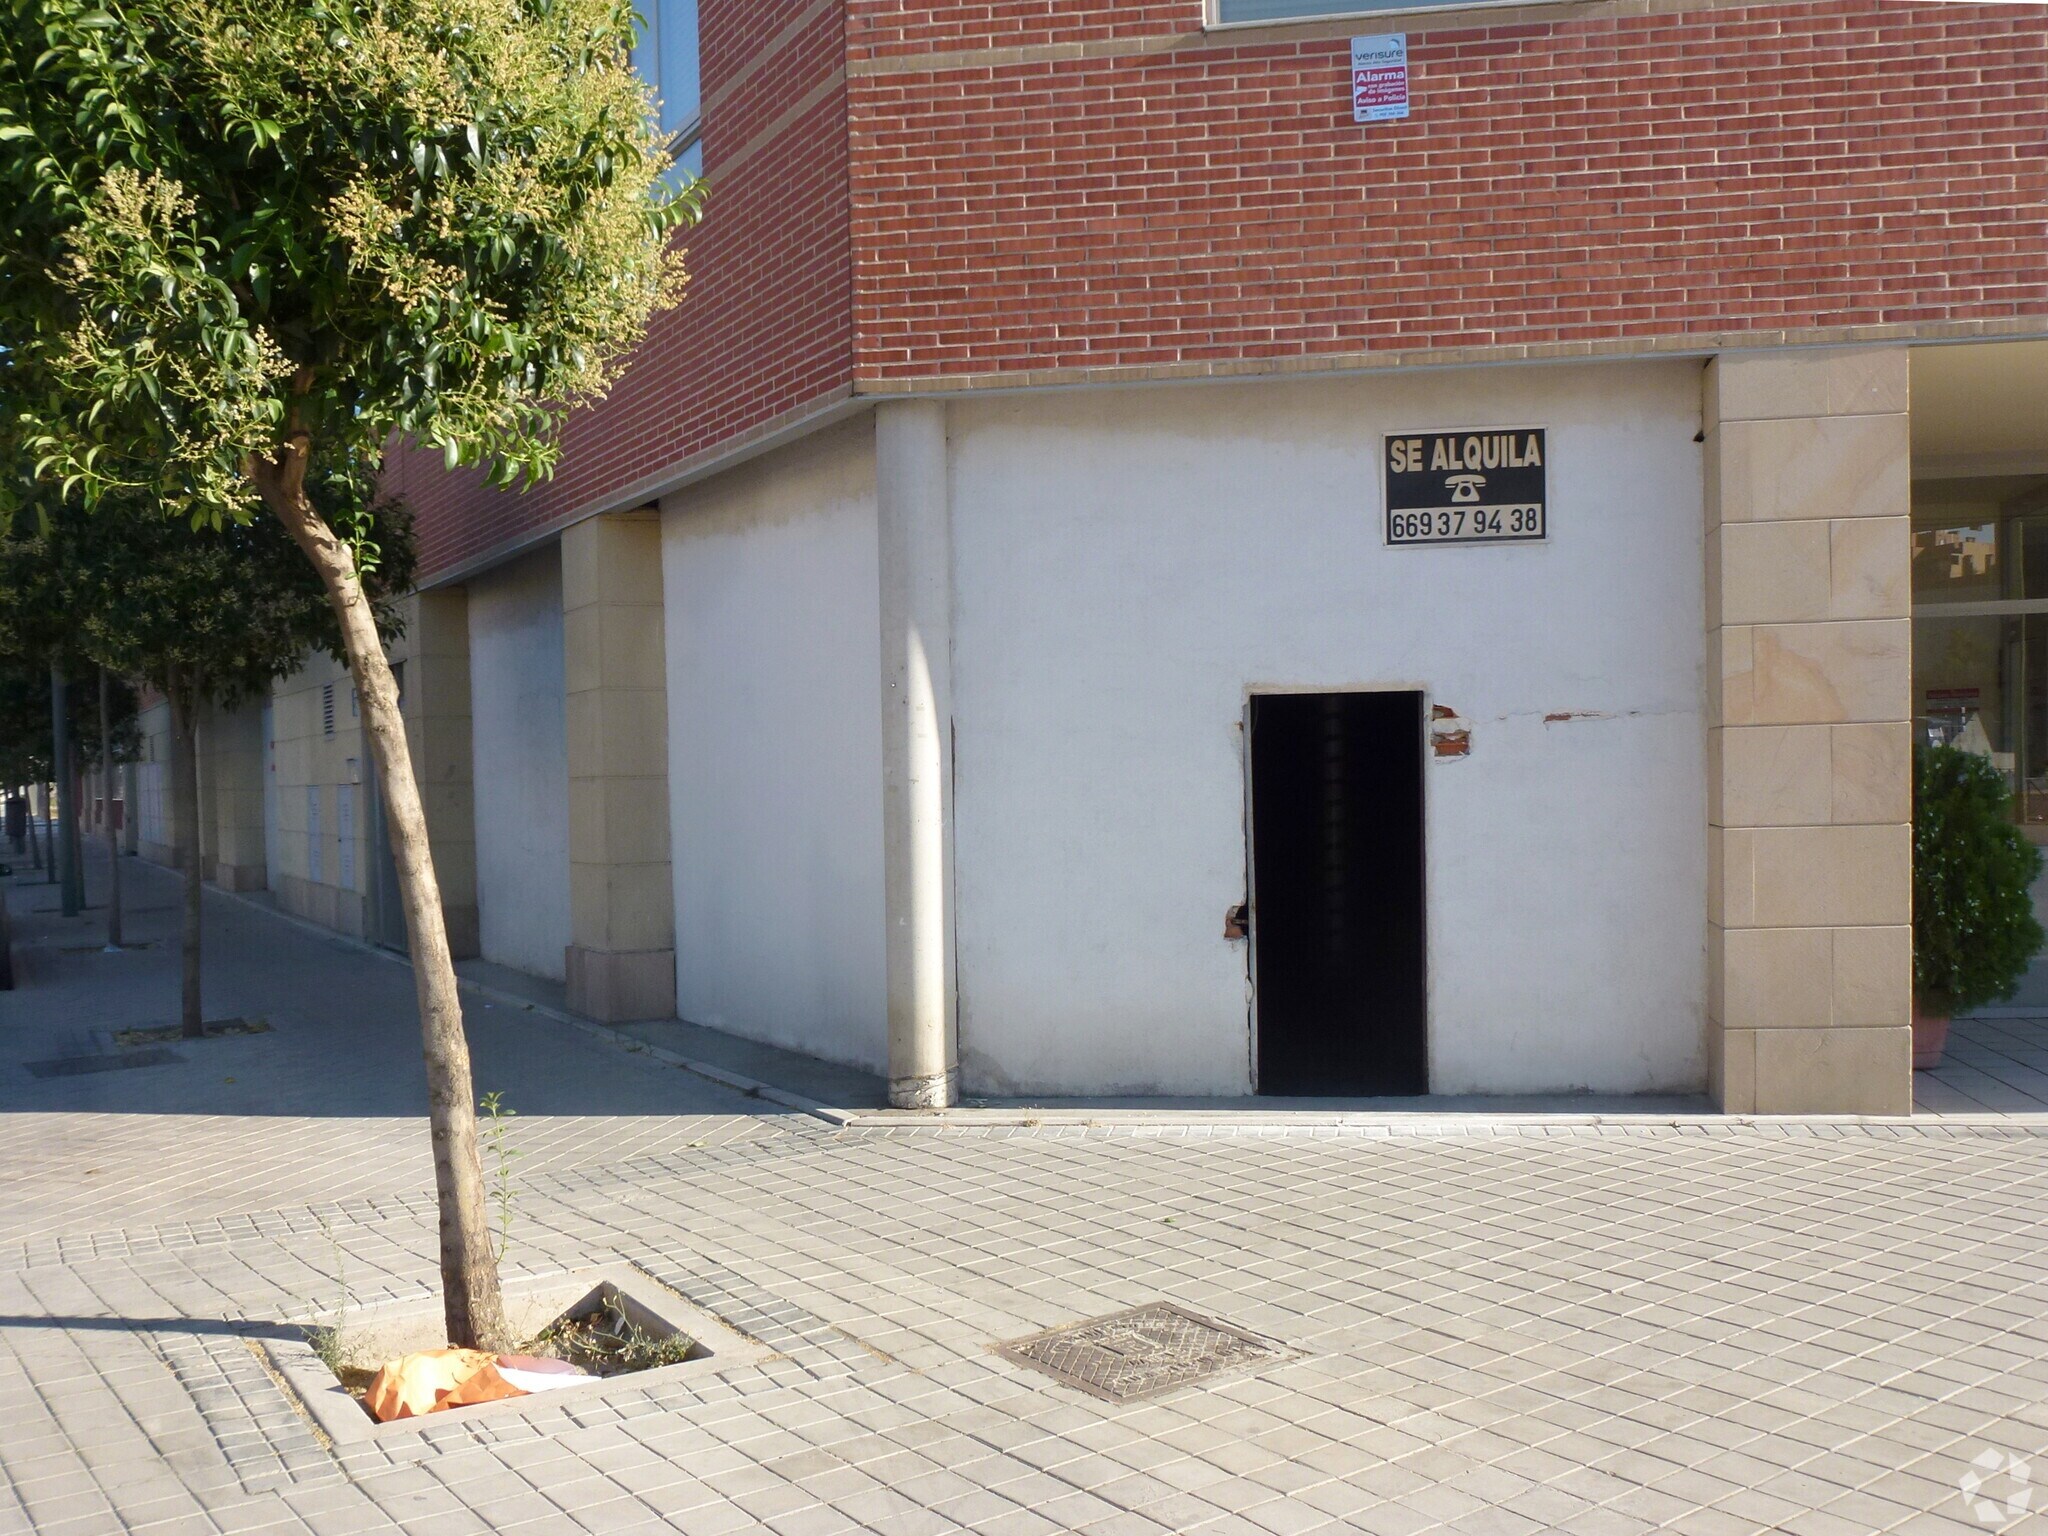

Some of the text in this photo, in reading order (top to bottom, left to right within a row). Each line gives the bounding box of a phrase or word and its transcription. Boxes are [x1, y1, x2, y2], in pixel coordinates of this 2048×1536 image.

[1355, 49, 1403, 60] verisure
[1357, 71, 1404, 83] Alarma
[1358, 96, 1376, 104] Aviso
[1390, 434, 1542, 473] SE ALQUILA
[1392, 507, 1537, 538] 669 37 94 38
